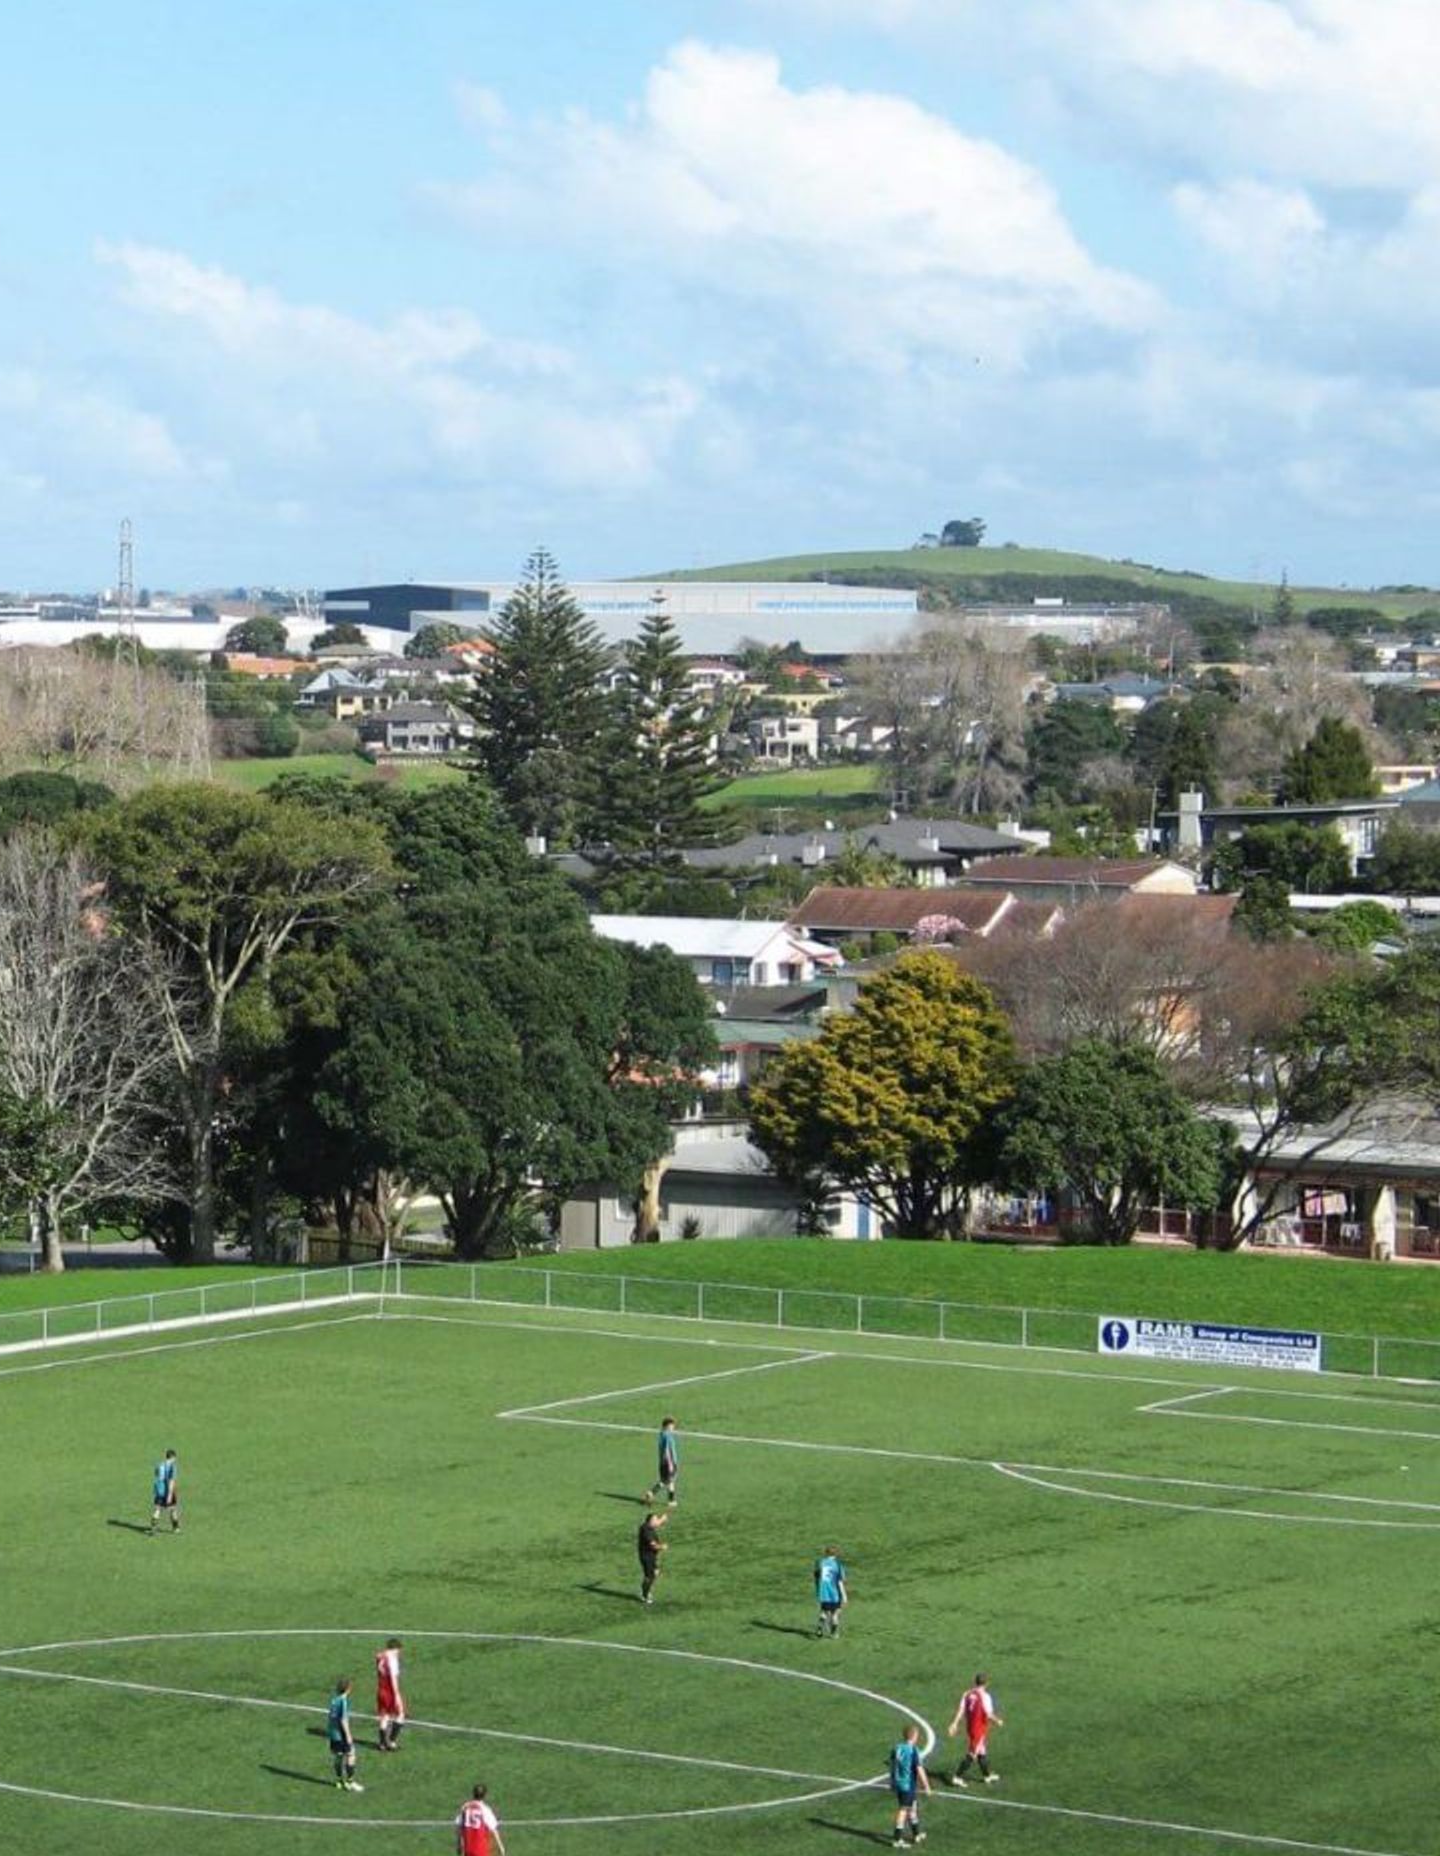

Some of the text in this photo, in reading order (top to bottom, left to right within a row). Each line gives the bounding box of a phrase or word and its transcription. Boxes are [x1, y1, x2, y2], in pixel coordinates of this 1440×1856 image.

[1140, 1321, 1313, 1346] RAMS Group of Companies Ltd
[465, 1808, 482, 1829] 15
